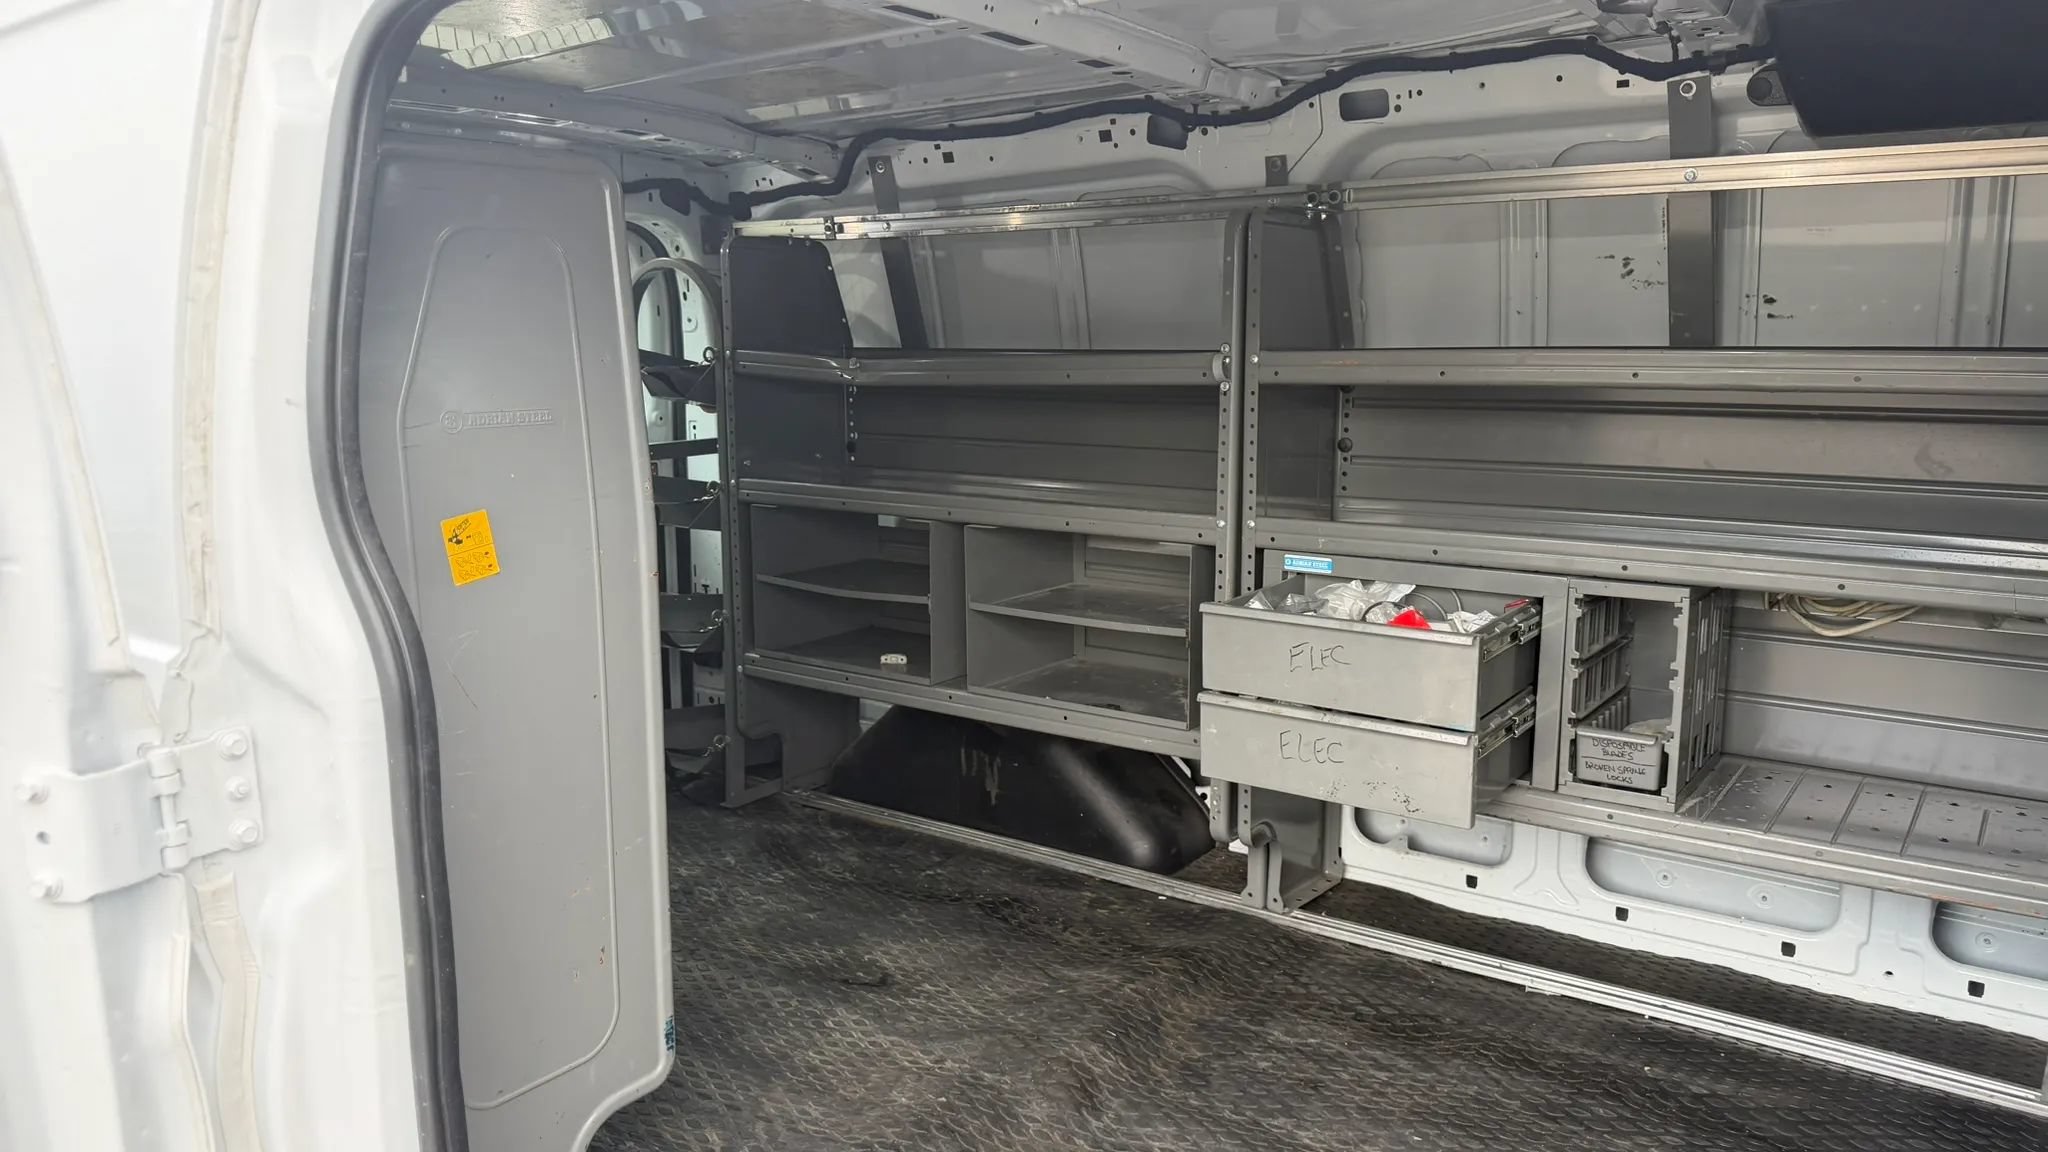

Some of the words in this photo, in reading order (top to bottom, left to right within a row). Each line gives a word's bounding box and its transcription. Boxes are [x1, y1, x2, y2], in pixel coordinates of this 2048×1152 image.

[1289, 641, 1352, 672] ELEC
[1280, 730, 1344, 763] ELEC
[1592, 737, 1646, 752] DISPOSABLE
[1602, 748, 1633, 760] BLADES
[1606, 773, 1633, 785] LOCKS
